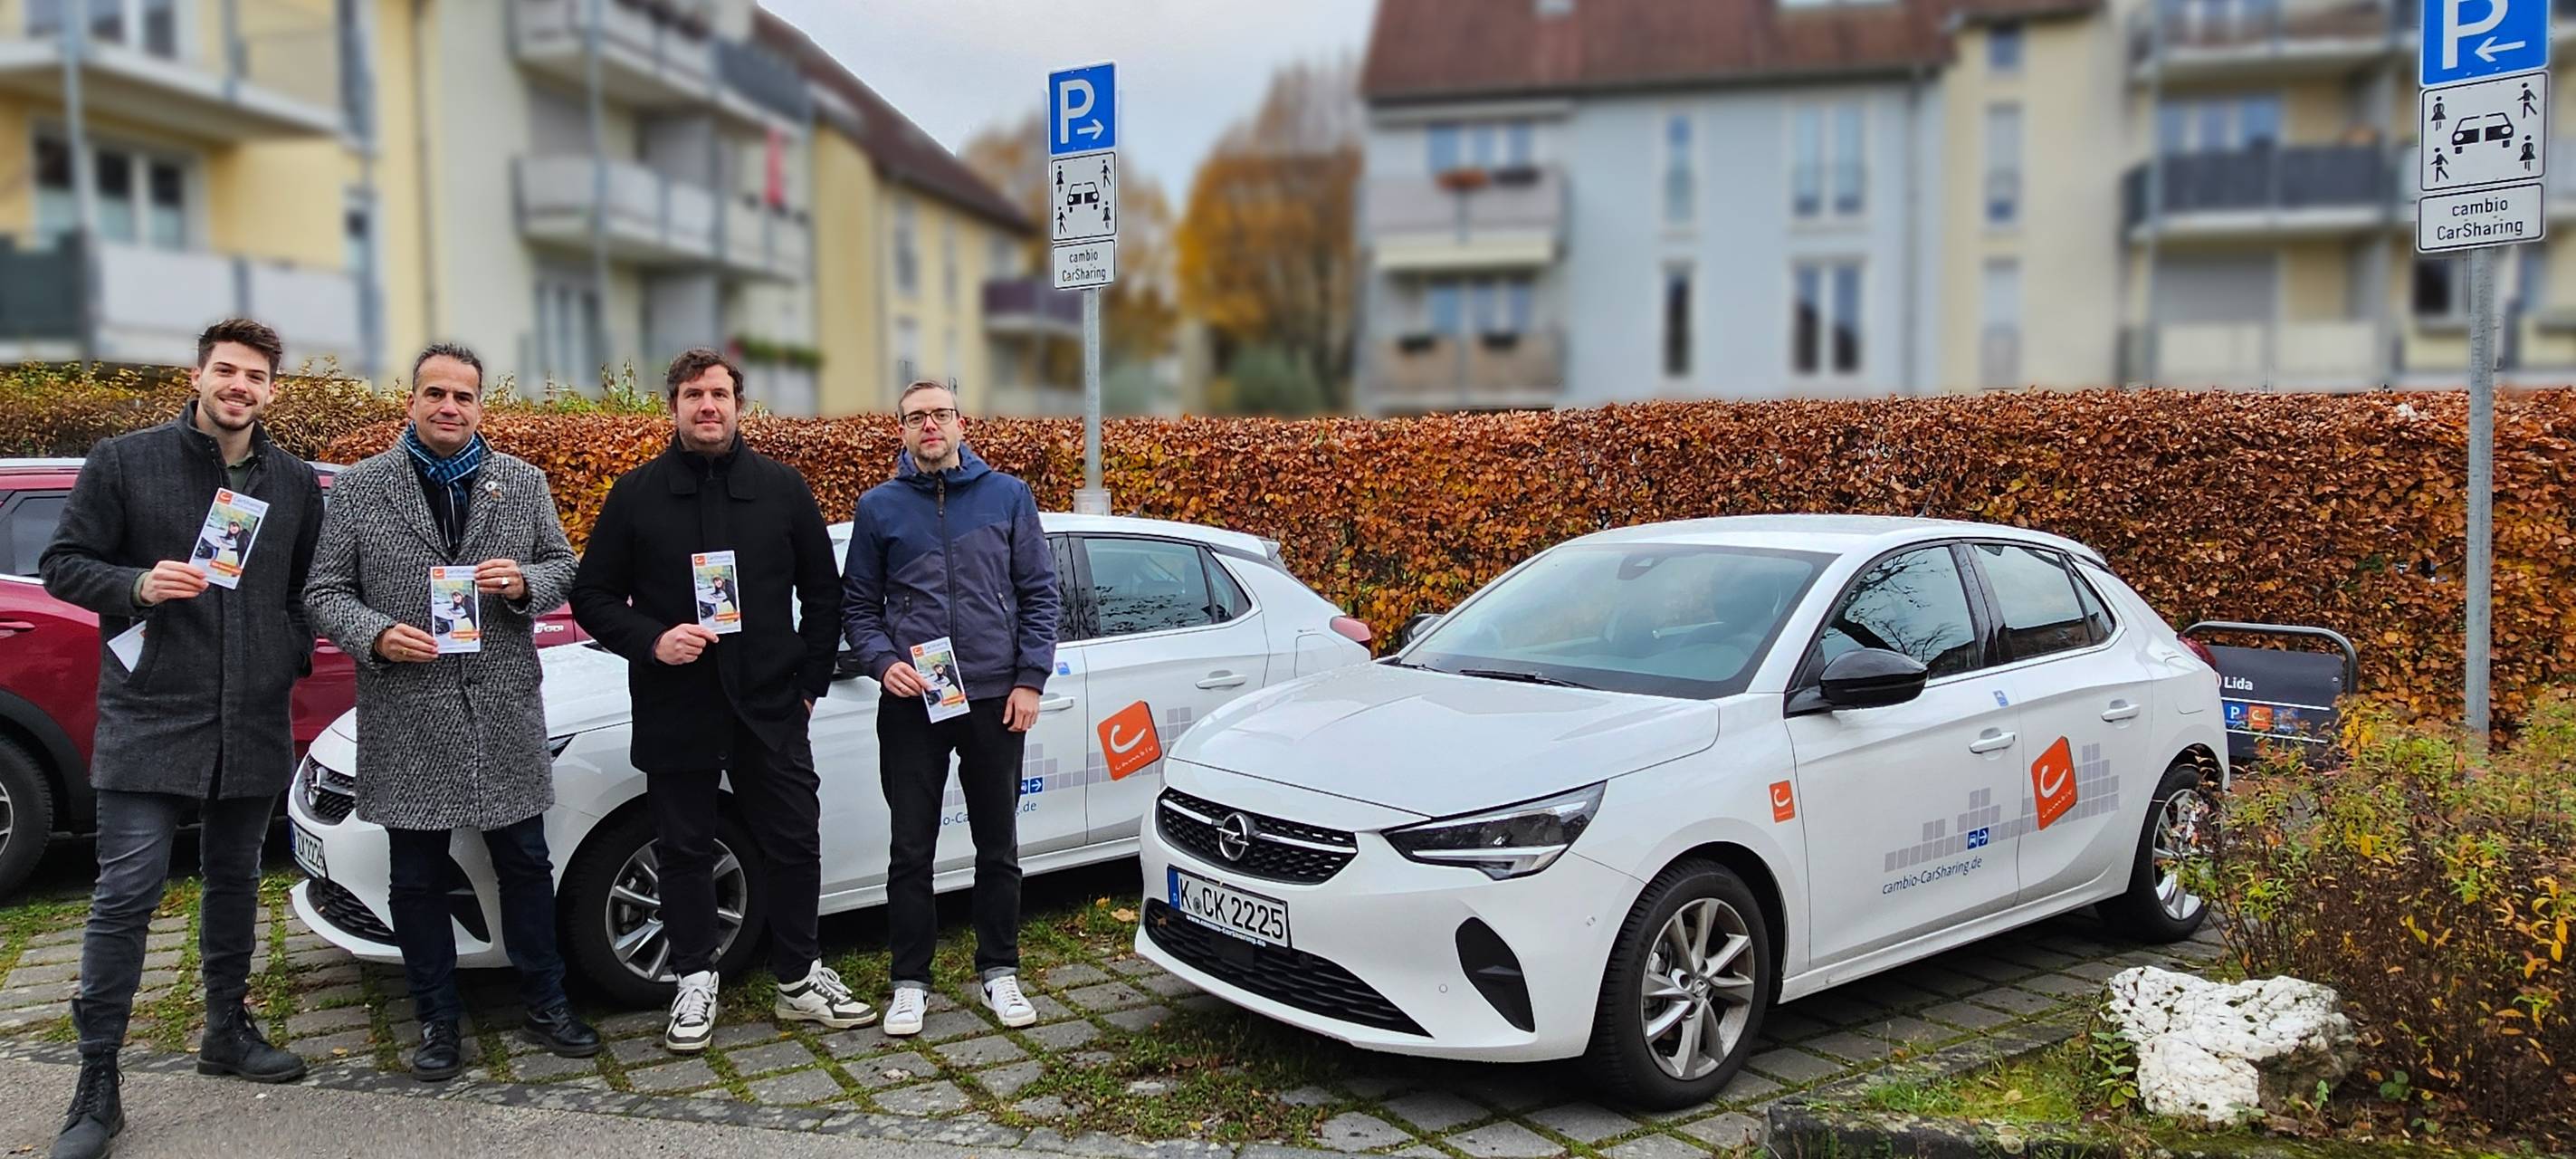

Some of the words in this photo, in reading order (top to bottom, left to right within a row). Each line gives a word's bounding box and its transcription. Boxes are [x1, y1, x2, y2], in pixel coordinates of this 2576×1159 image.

[2442, 0, 2508, 70] P
[1059, 79, 1095, 144] P
[2452, 196, 2508, 216] cambio
[2437, 219, 2524, 241] CarSharing
[1069, 249, 1099, 263] cambio
[1062, 266, 1106, 283] CarSharing
[2224, 676, 2254, 691] Lida
[1882, 856, 1983, 895] cambio-CarSharing.de
[1179, 877, 1192, 910] K
[1202, 886, 1227, 924] CK
[1231, 896, 1284, 939] 2225
